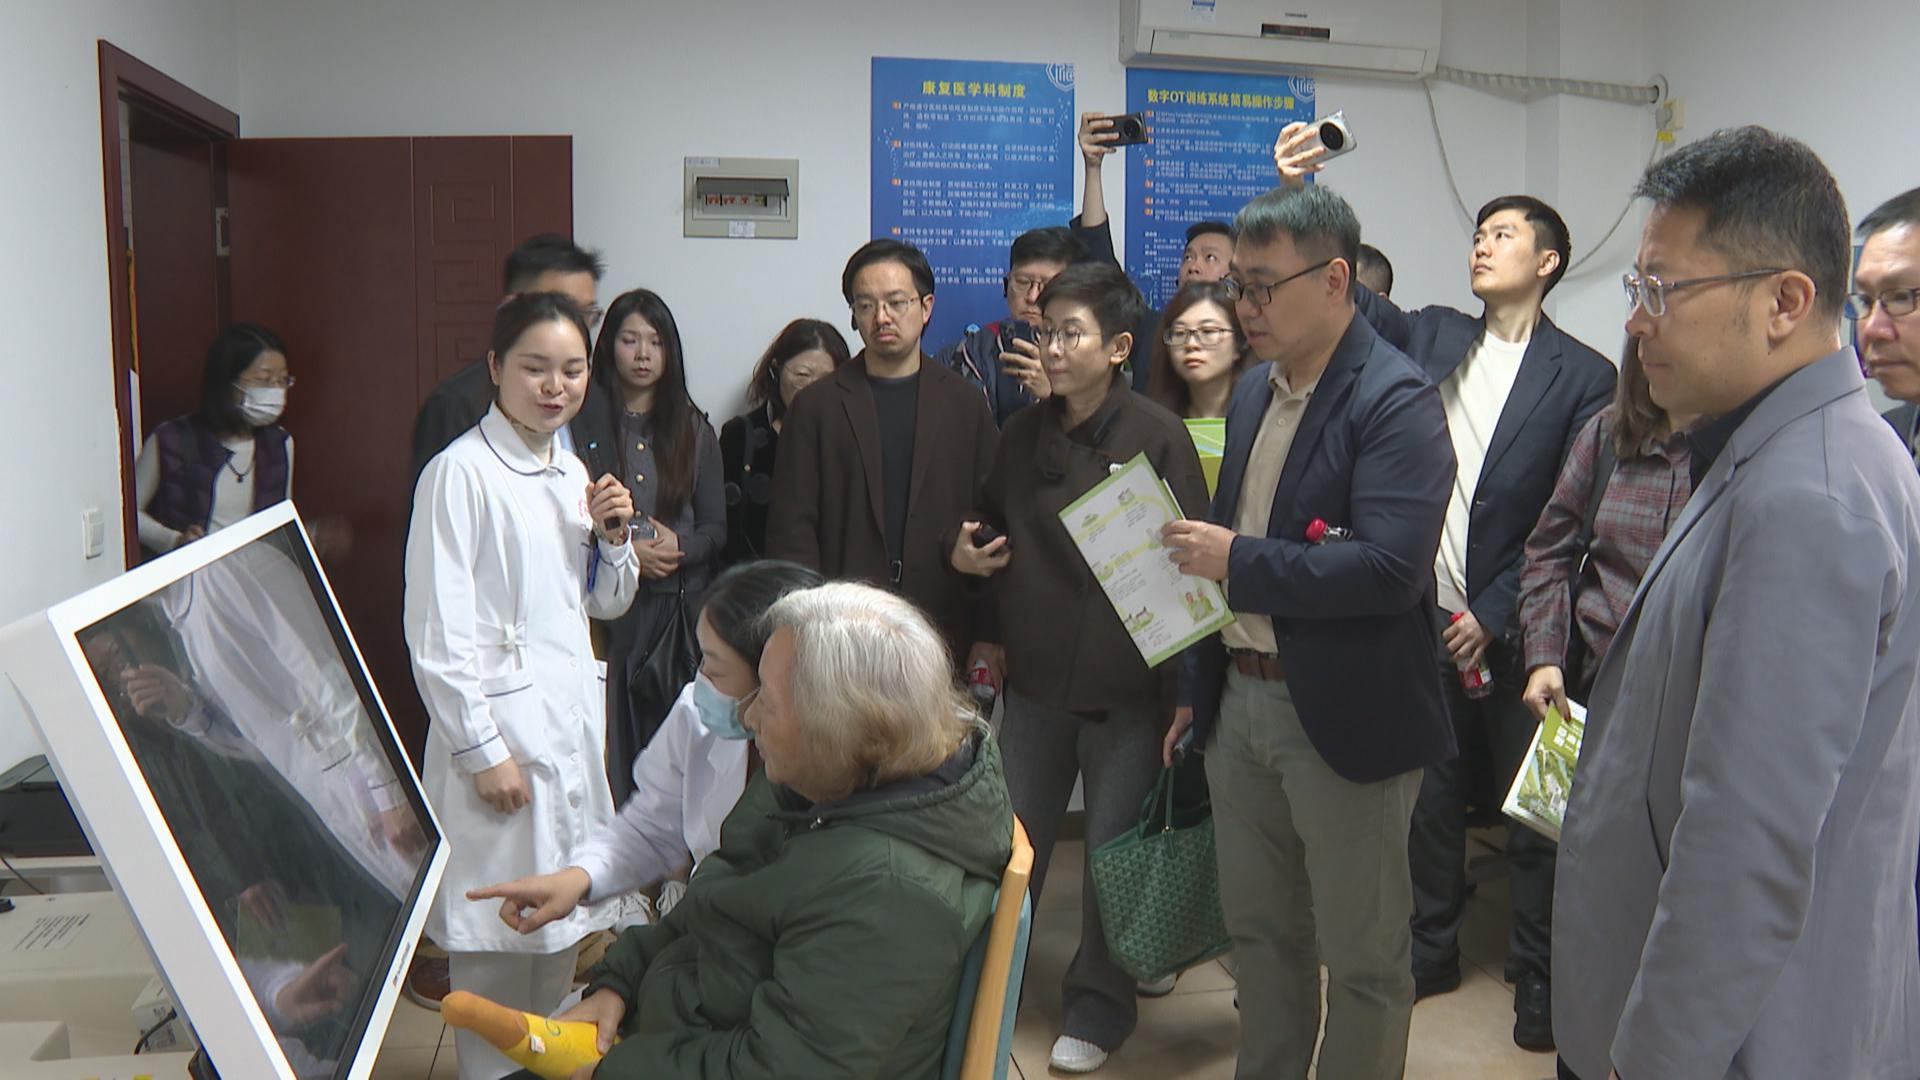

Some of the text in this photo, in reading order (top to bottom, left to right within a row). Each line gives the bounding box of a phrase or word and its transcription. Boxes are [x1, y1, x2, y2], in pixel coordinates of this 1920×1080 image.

[922, 80, 1026, 99] 康复医学科制度
[1147, 88, 1295, 111] 数字OT训练系统简易操作步骤
